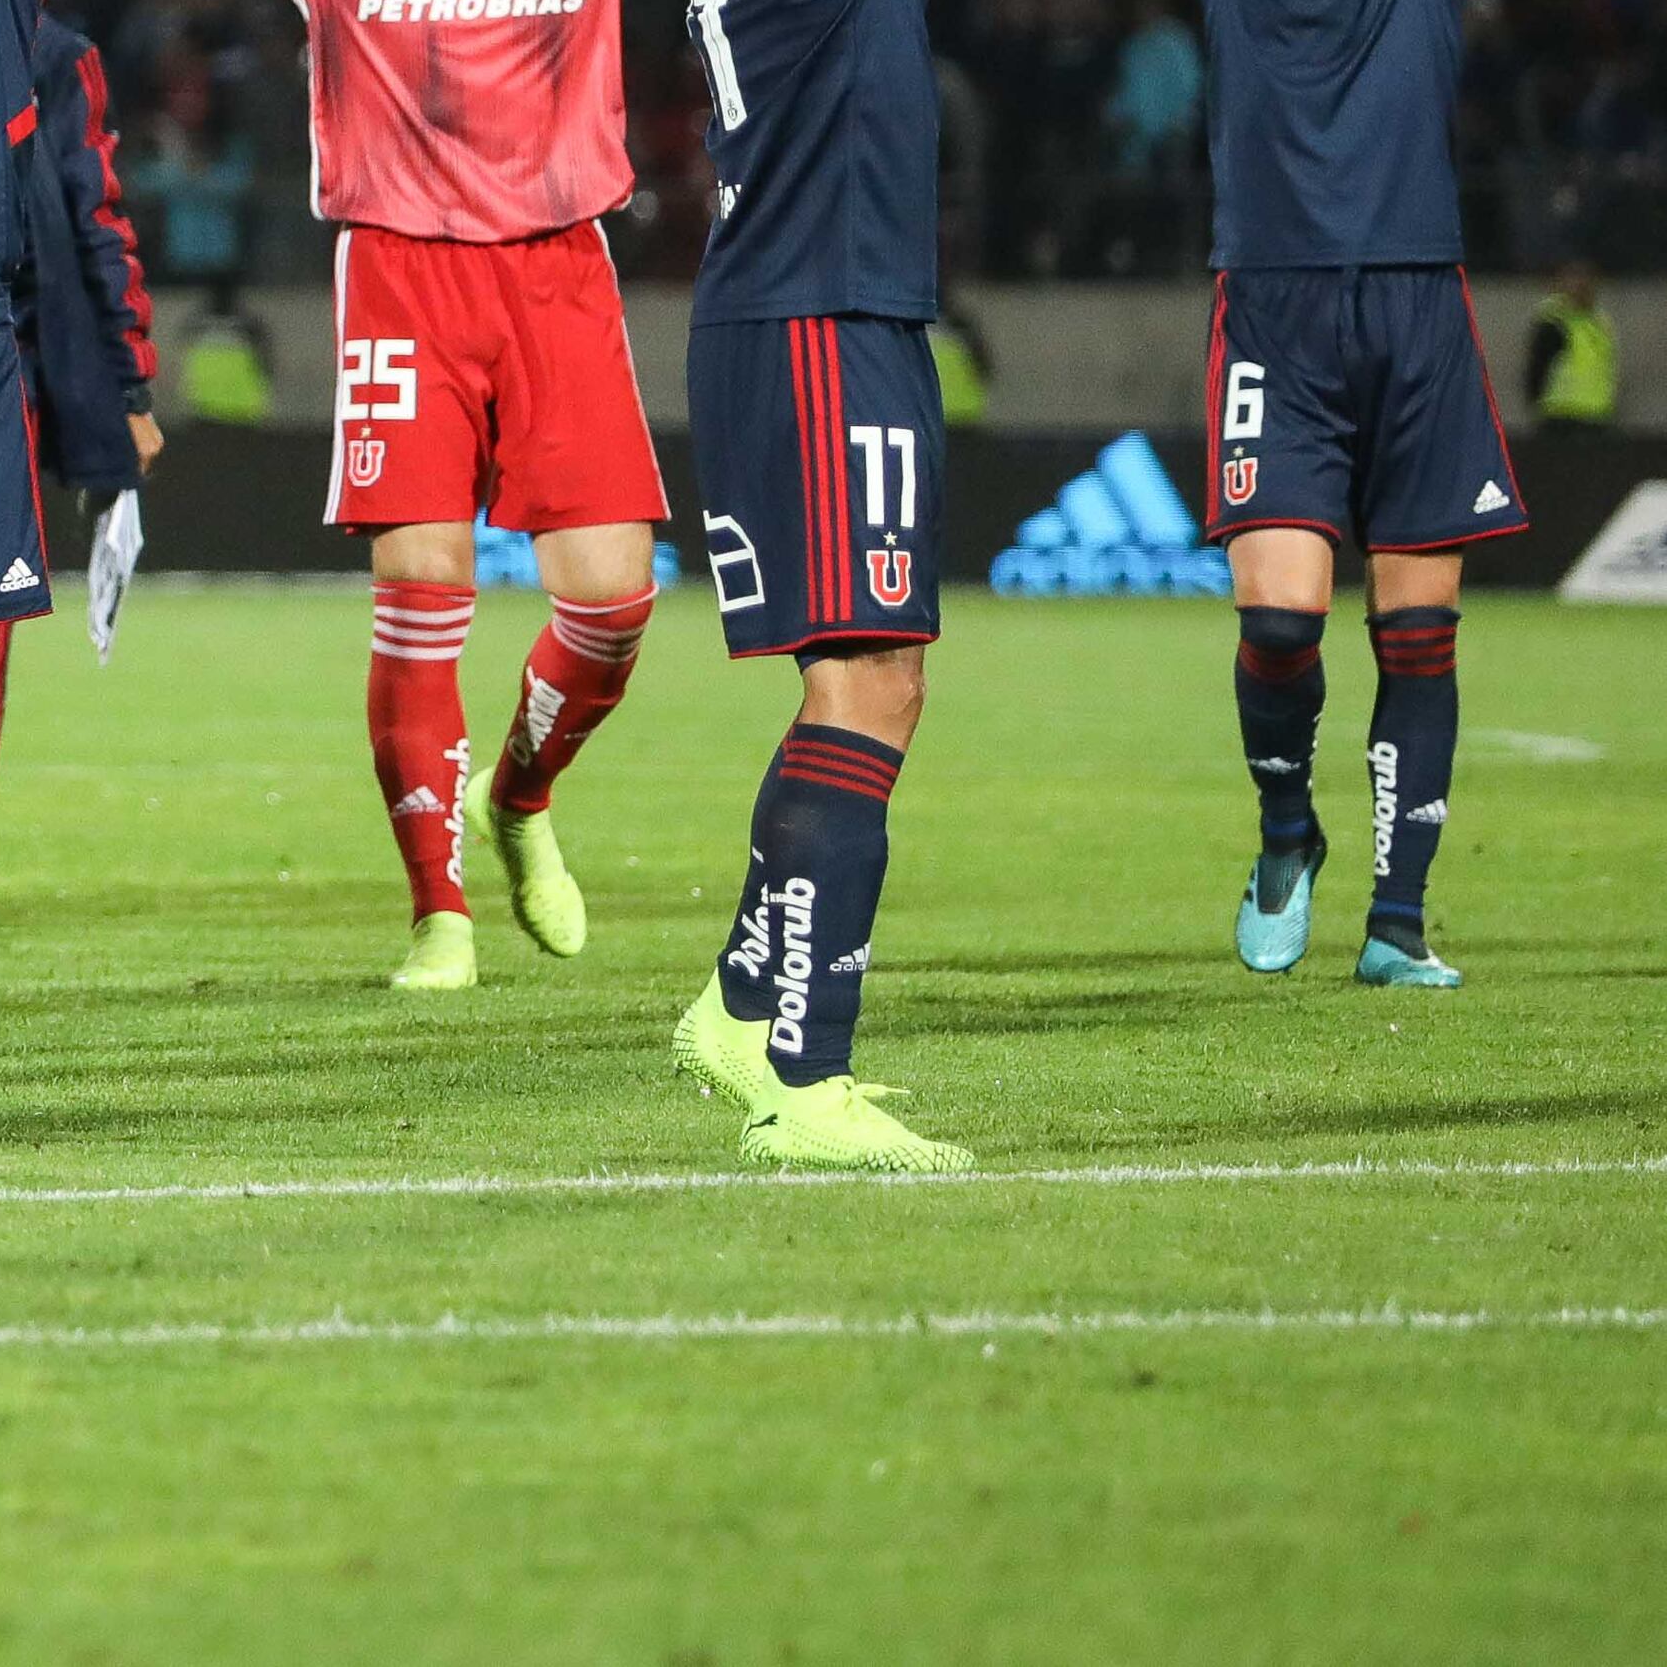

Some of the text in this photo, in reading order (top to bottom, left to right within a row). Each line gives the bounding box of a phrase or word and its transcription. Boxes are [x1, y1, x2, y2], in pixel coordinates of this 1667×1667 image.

[340, 337, 417, 421] 25
[1223, 360, 1266, 441] 6
[348, 439, 386, 489] U
[849, 425, 916, 529] 11
[1223, 456, 1259, 507] U
[865, 549, 912, 607] U
[769, 876, 816, 1054] Dolorub
